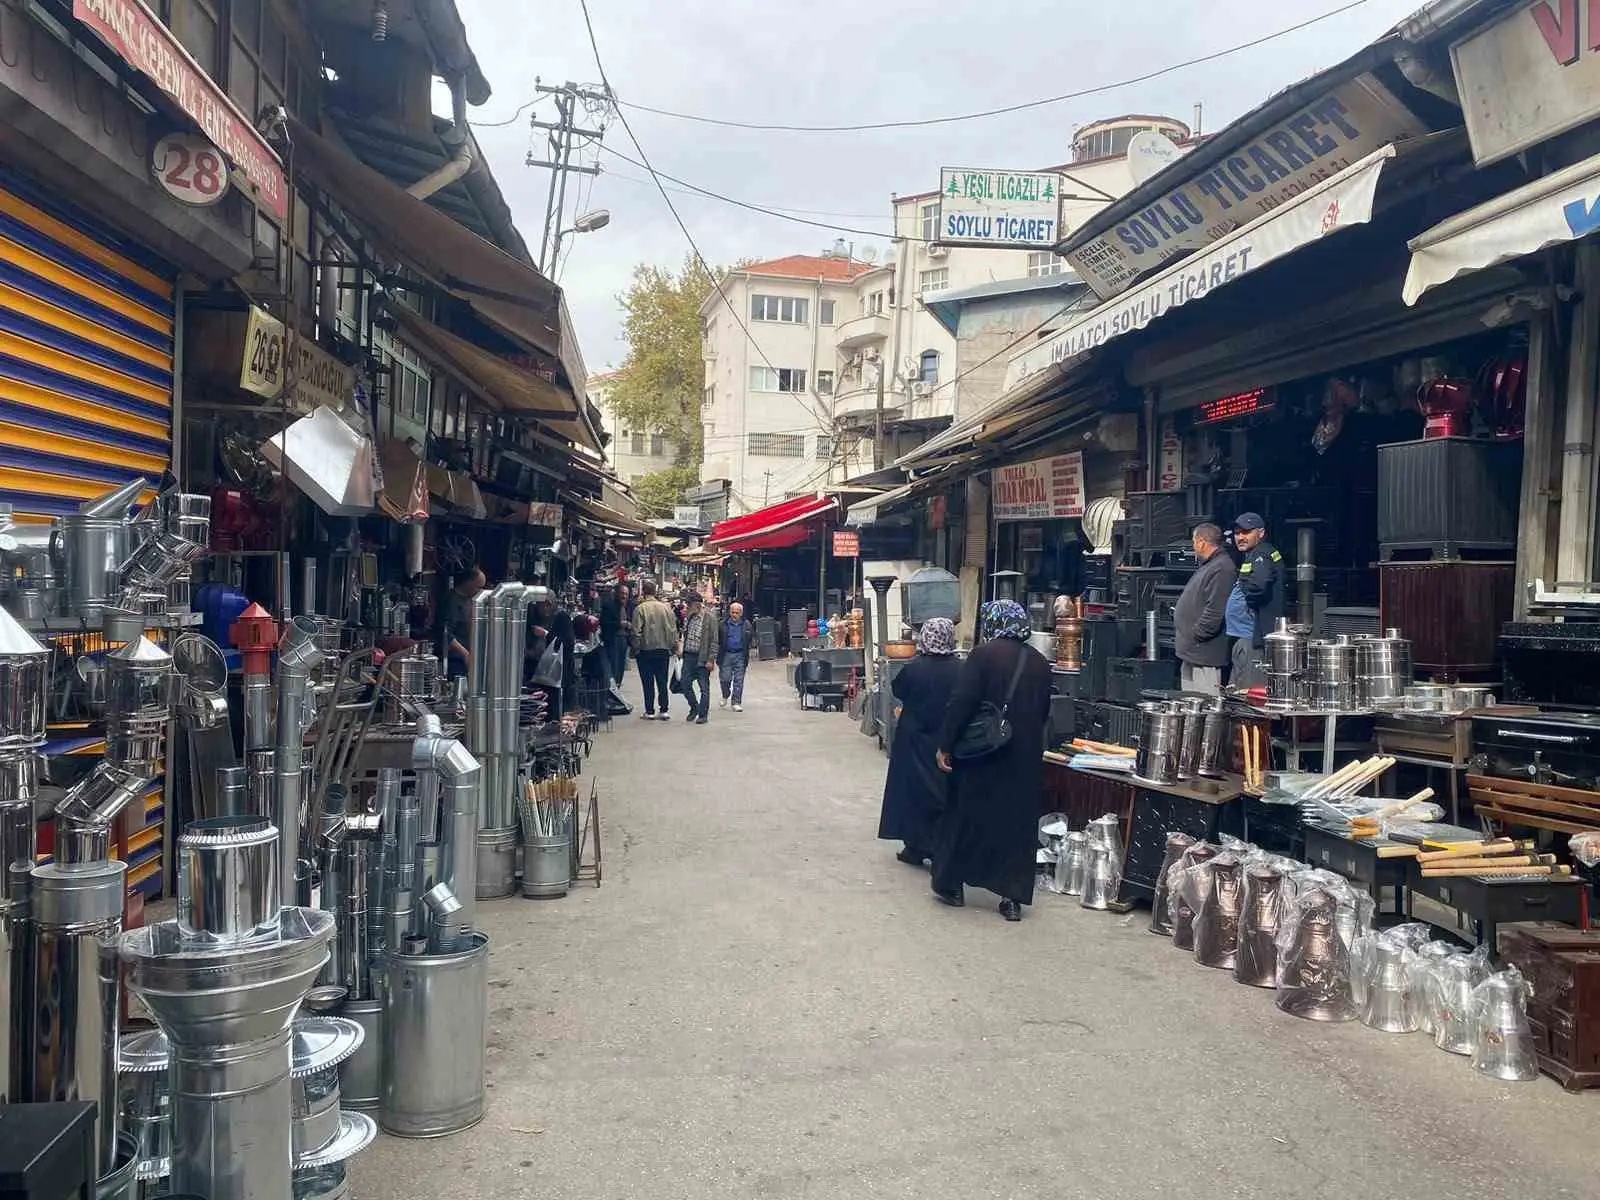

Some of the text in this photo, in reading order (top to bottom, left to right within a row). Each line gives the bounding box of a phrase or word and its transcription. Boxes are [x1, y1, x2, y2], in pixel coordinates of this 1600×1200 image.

[198, 90, 231, 149] TENTE
[165, 143, 220, 195] 28
[948, 212, 1054, 240] SOYLU TİCARET
[1116, 193, 1204, 255] SOYLU
[1112, 293, 1161, 334] SOYLU
[1169, 247, 1252, 306] TİCARET
